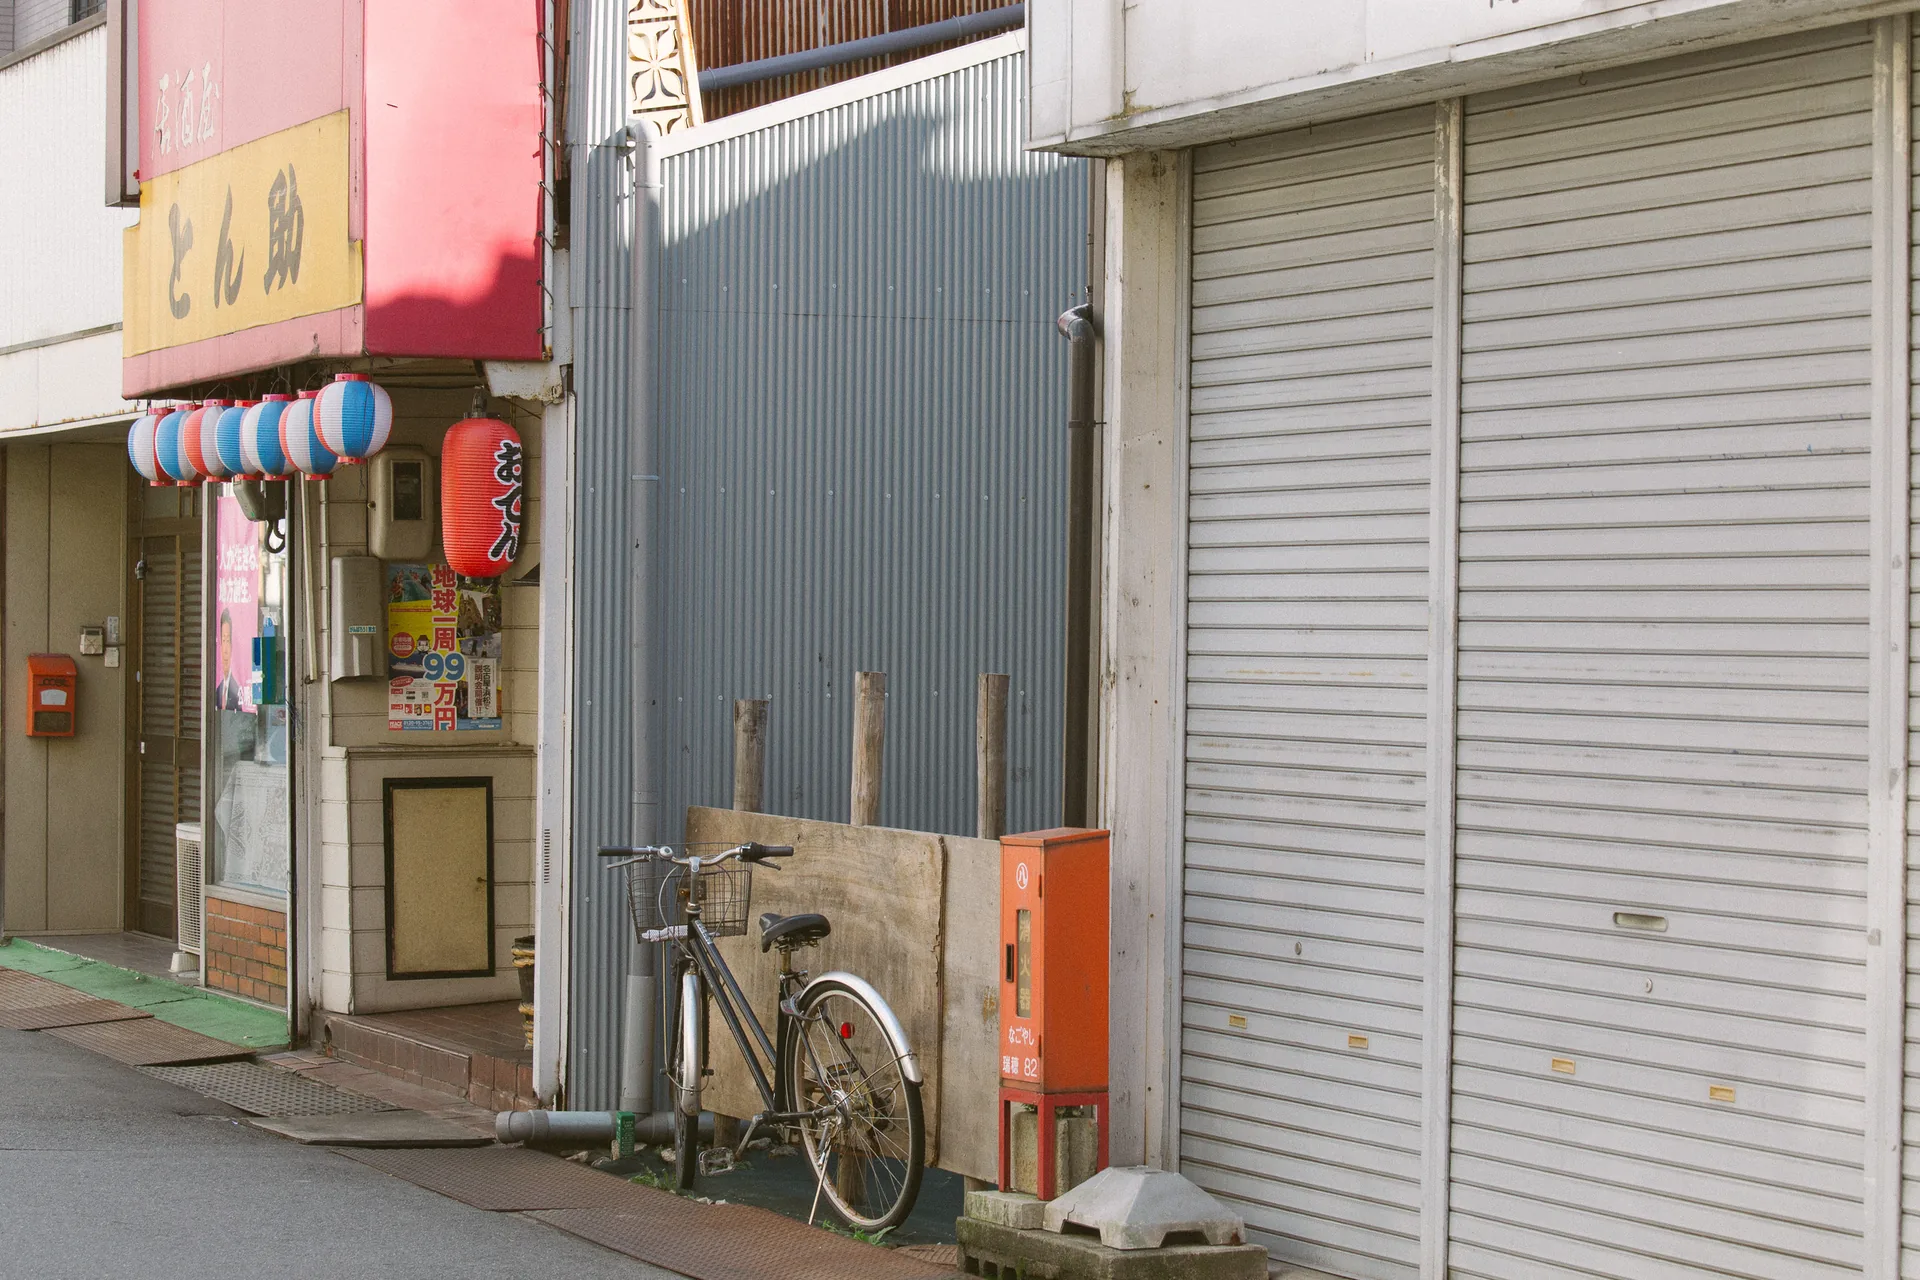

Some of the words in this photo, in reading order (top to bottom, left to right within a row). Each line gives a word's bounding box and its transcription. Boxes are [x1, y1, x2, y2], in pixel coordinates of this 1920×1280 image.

[151, 61, 220, 160] 居酒屋
[168, 163, 305, 320] とん助
[488, 440, 522, 561] おでん
[1019, 924, 1031, 1011] 消火器
[1008, 1025, 1035, 1046] なごやし
[1024, 1057, 1038, 1077] 82
